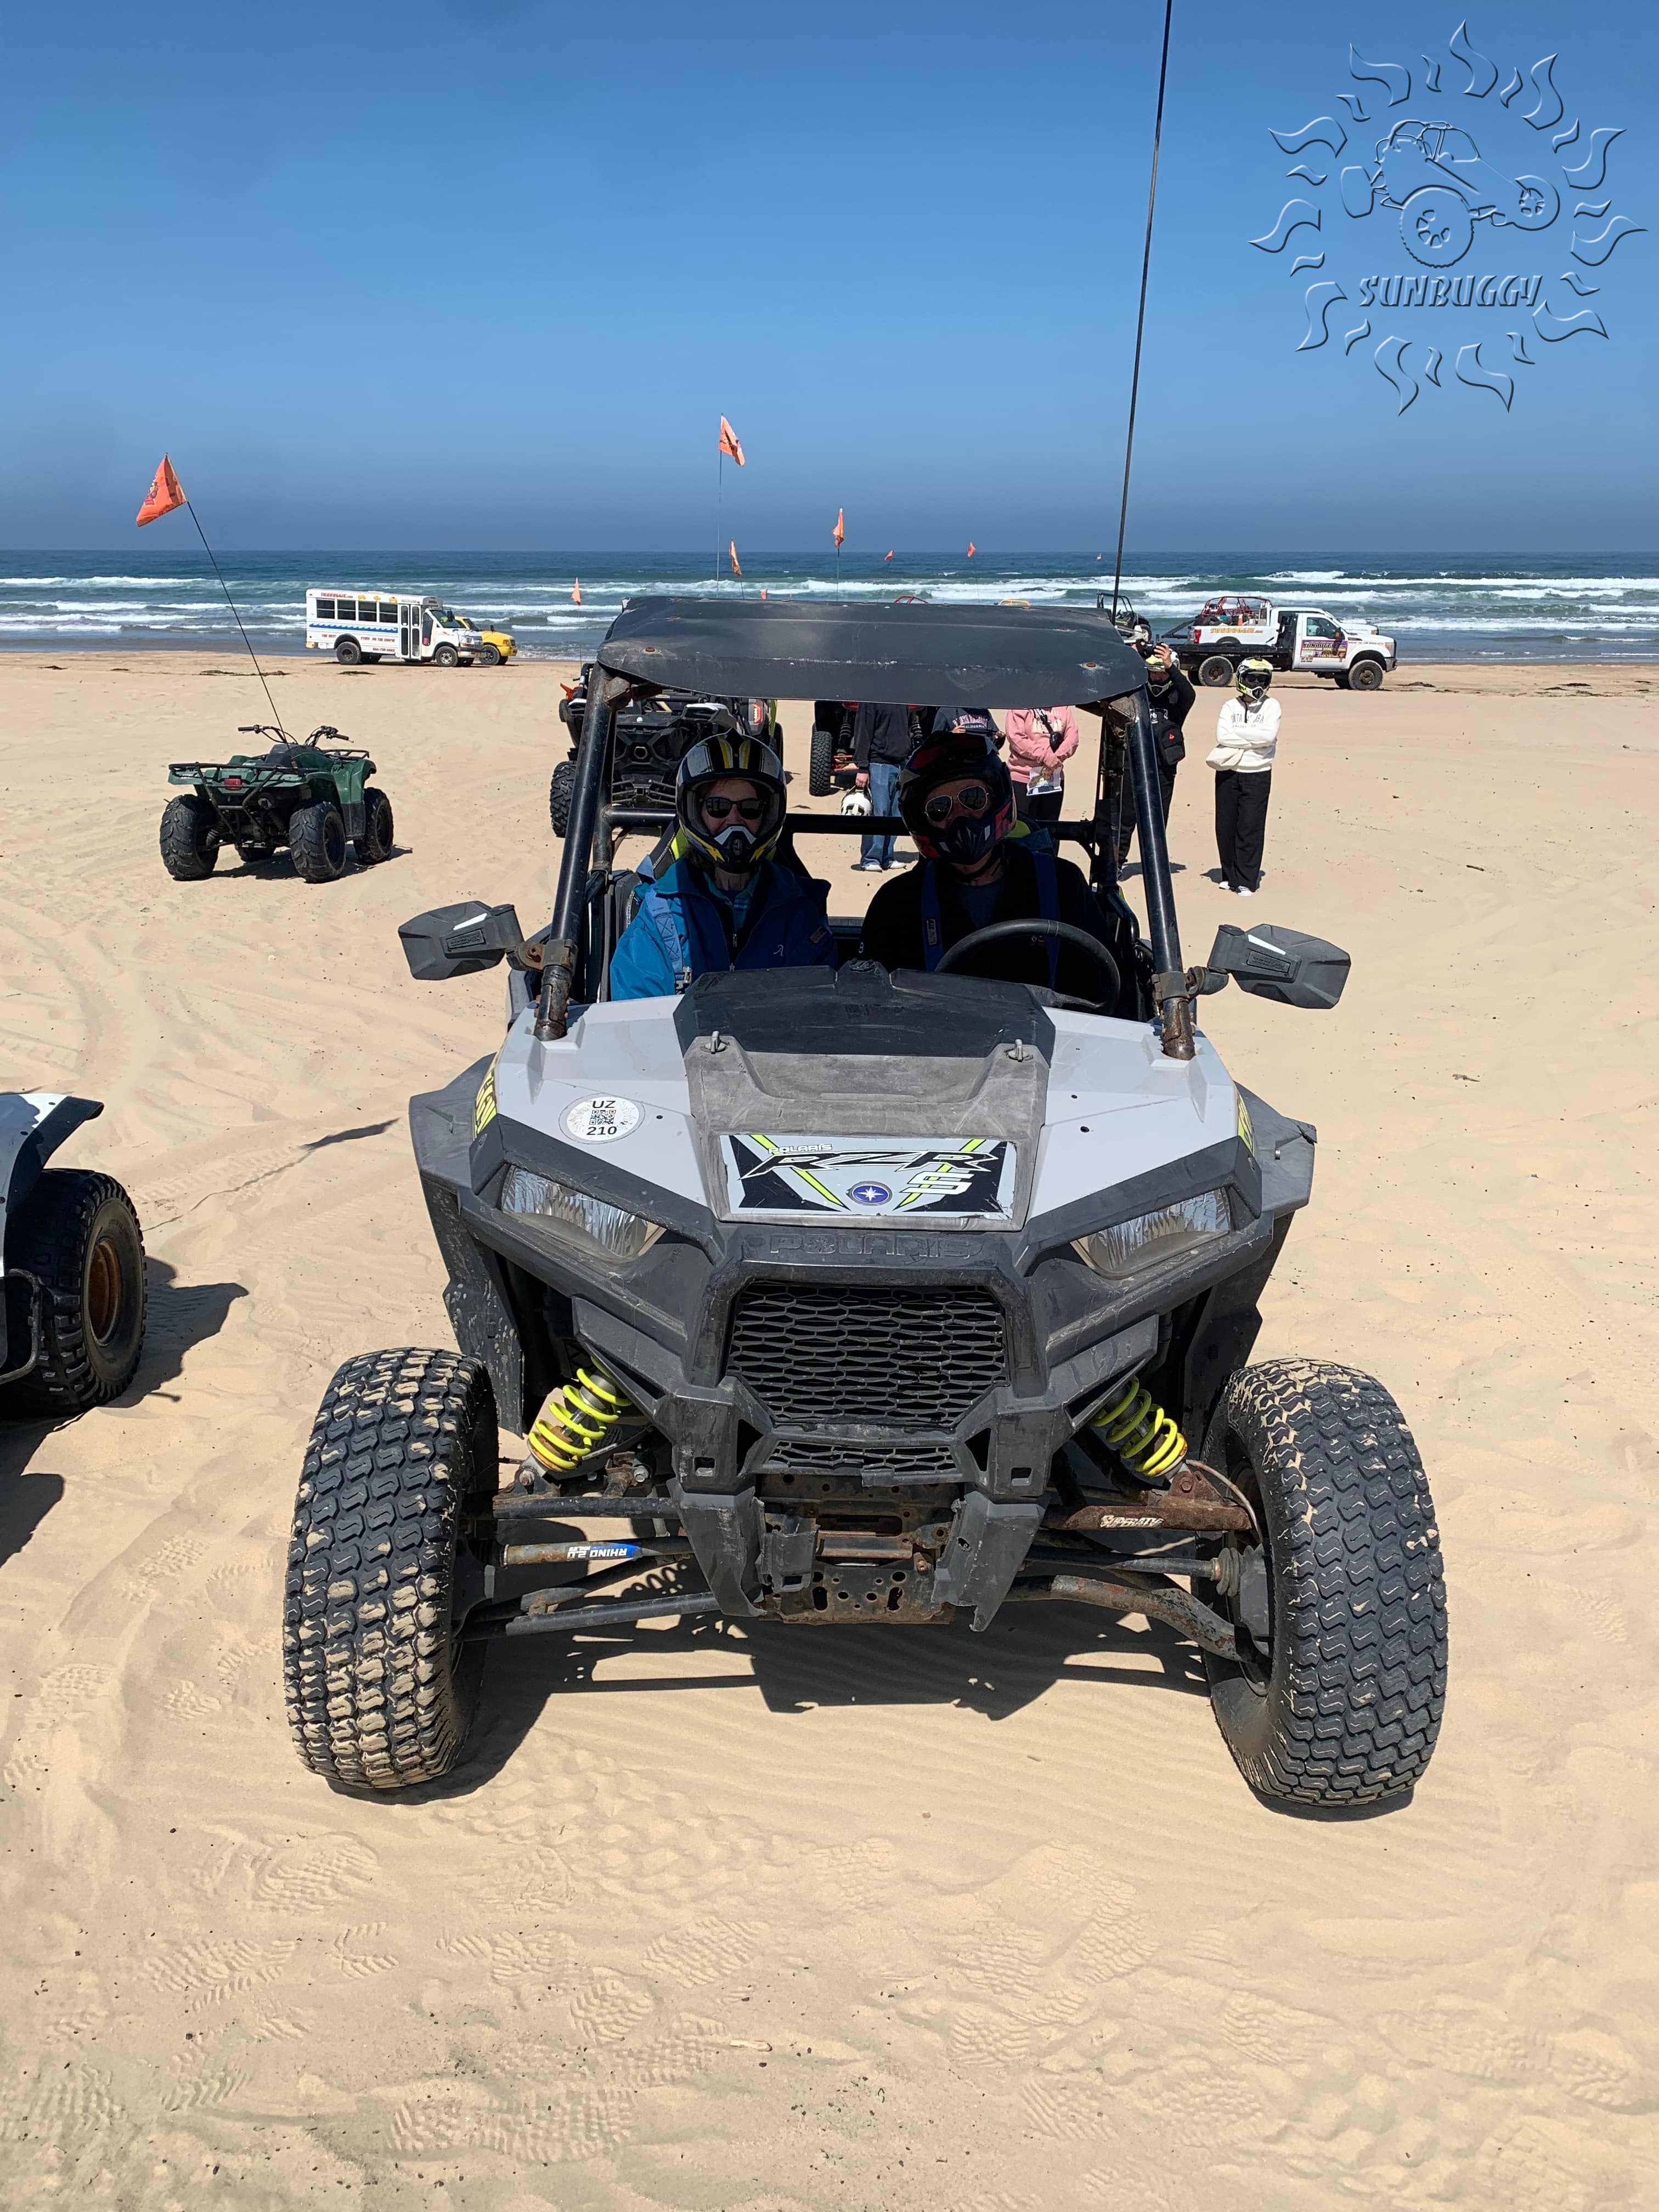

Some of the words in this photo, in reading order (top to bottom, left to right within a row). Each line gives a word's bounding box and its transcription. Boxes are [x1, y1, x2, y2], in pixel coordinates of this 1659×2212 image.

[592, 1101, 616, 1109] UZ
[586, 1126, 617, 1136] 210
[768, 1143, 833, 1154] POLARIS
[740, 1150, 1000, 1181] RZR
[769, 1233, 984, 1260] POLARIS
[566, 1550, 587, 1559] 2.0
[589, 1548, 628, 1558] RHINO
